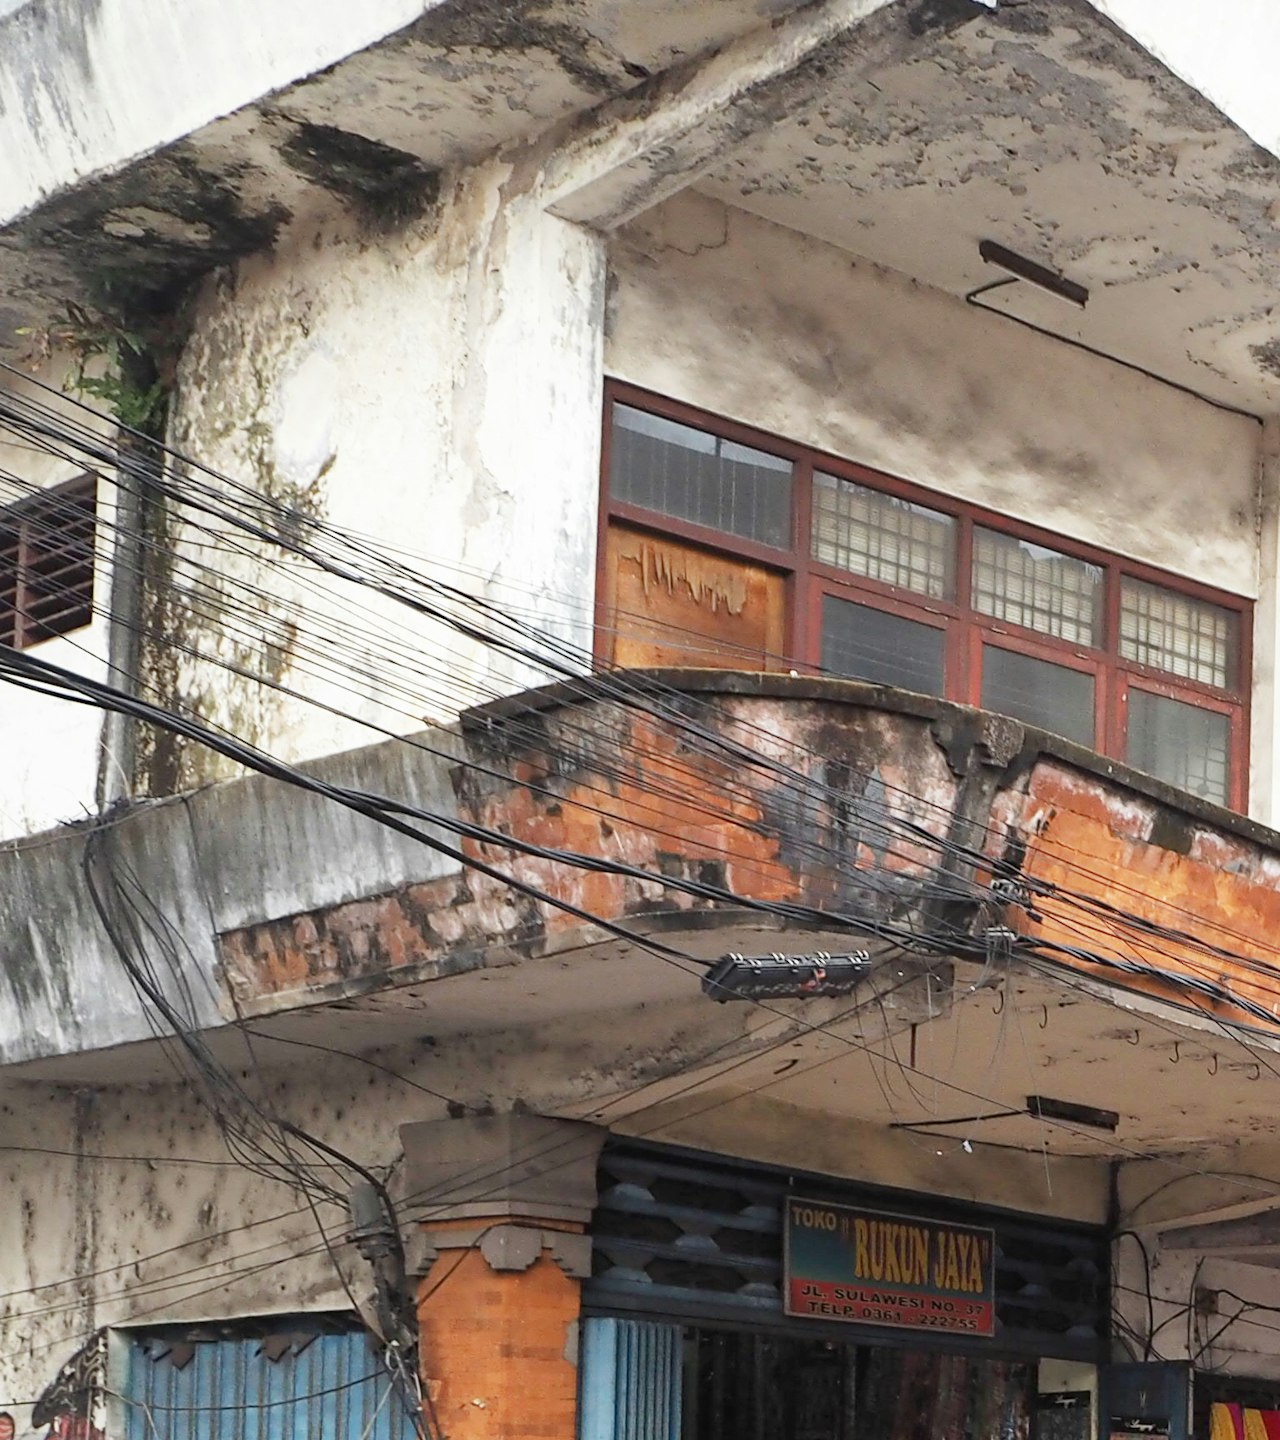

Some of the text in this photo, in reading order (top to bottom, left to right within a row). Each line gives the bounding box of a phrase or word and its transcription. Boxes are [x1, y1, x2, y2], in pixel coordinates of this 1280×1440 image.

[792, 1206, 837, 1231] TOKO
[801, 1285, 984, 1315] JL. SULAWESI NO. 37
[808, 1301, 855, 1318] TELP.
[862, 1308, 901, 1321] 0361
[919, 1314, 978, 1330] 222755
